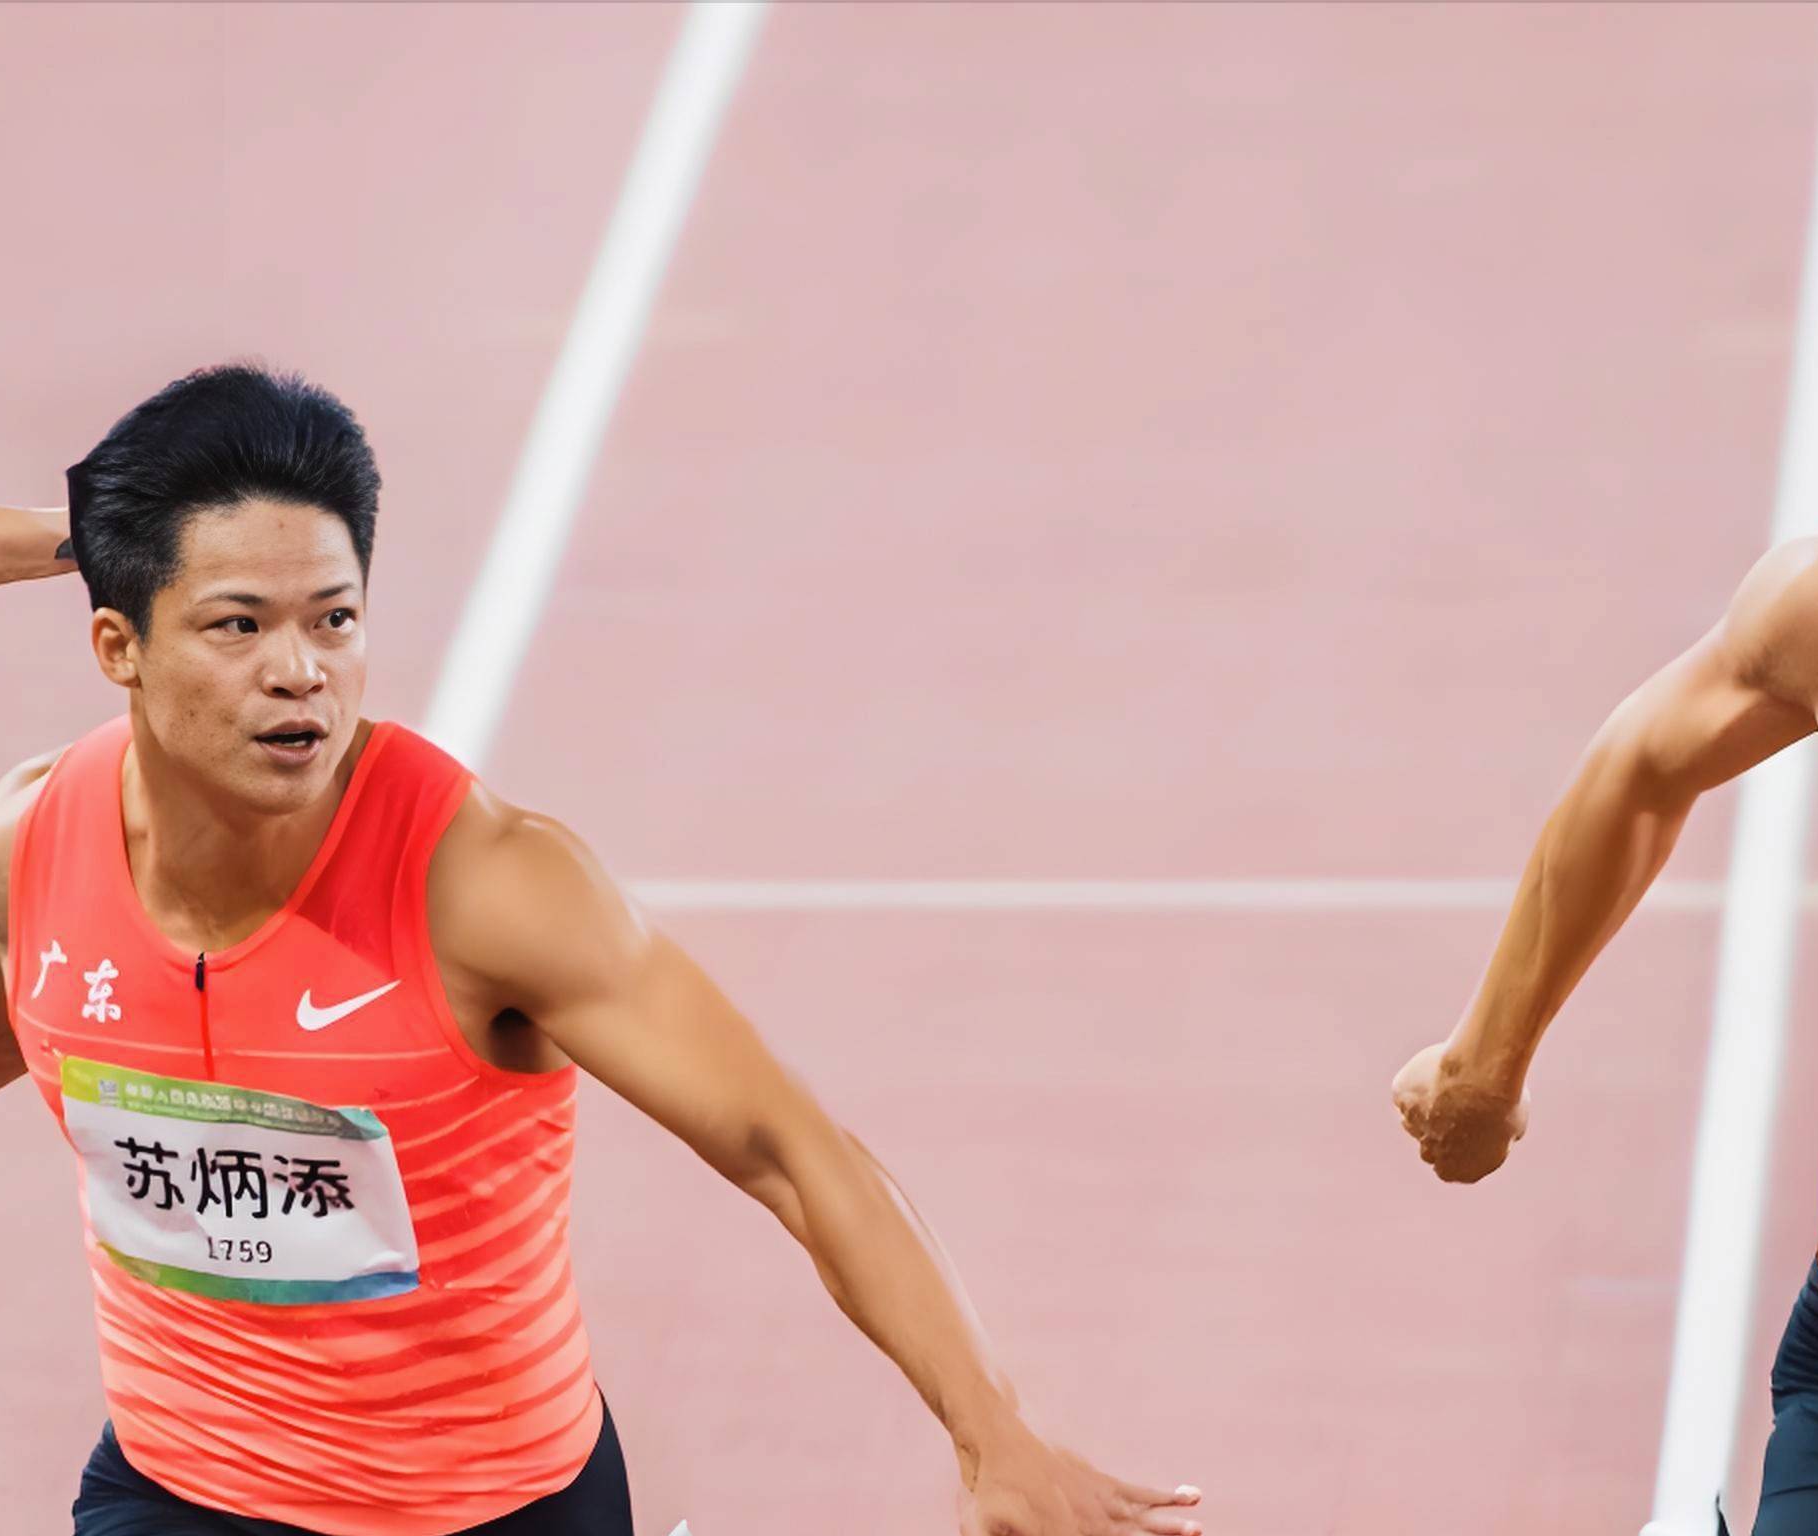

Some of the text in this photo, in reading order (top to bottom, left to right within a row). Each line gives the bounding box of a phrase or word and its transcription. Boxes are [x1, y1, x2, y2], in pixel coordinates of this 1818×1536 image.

[31, 939, 122, 1023] 广东
[114, 1136, 355, 1219] 苏炳添
[205, 1235, 274, 1265] 1759
